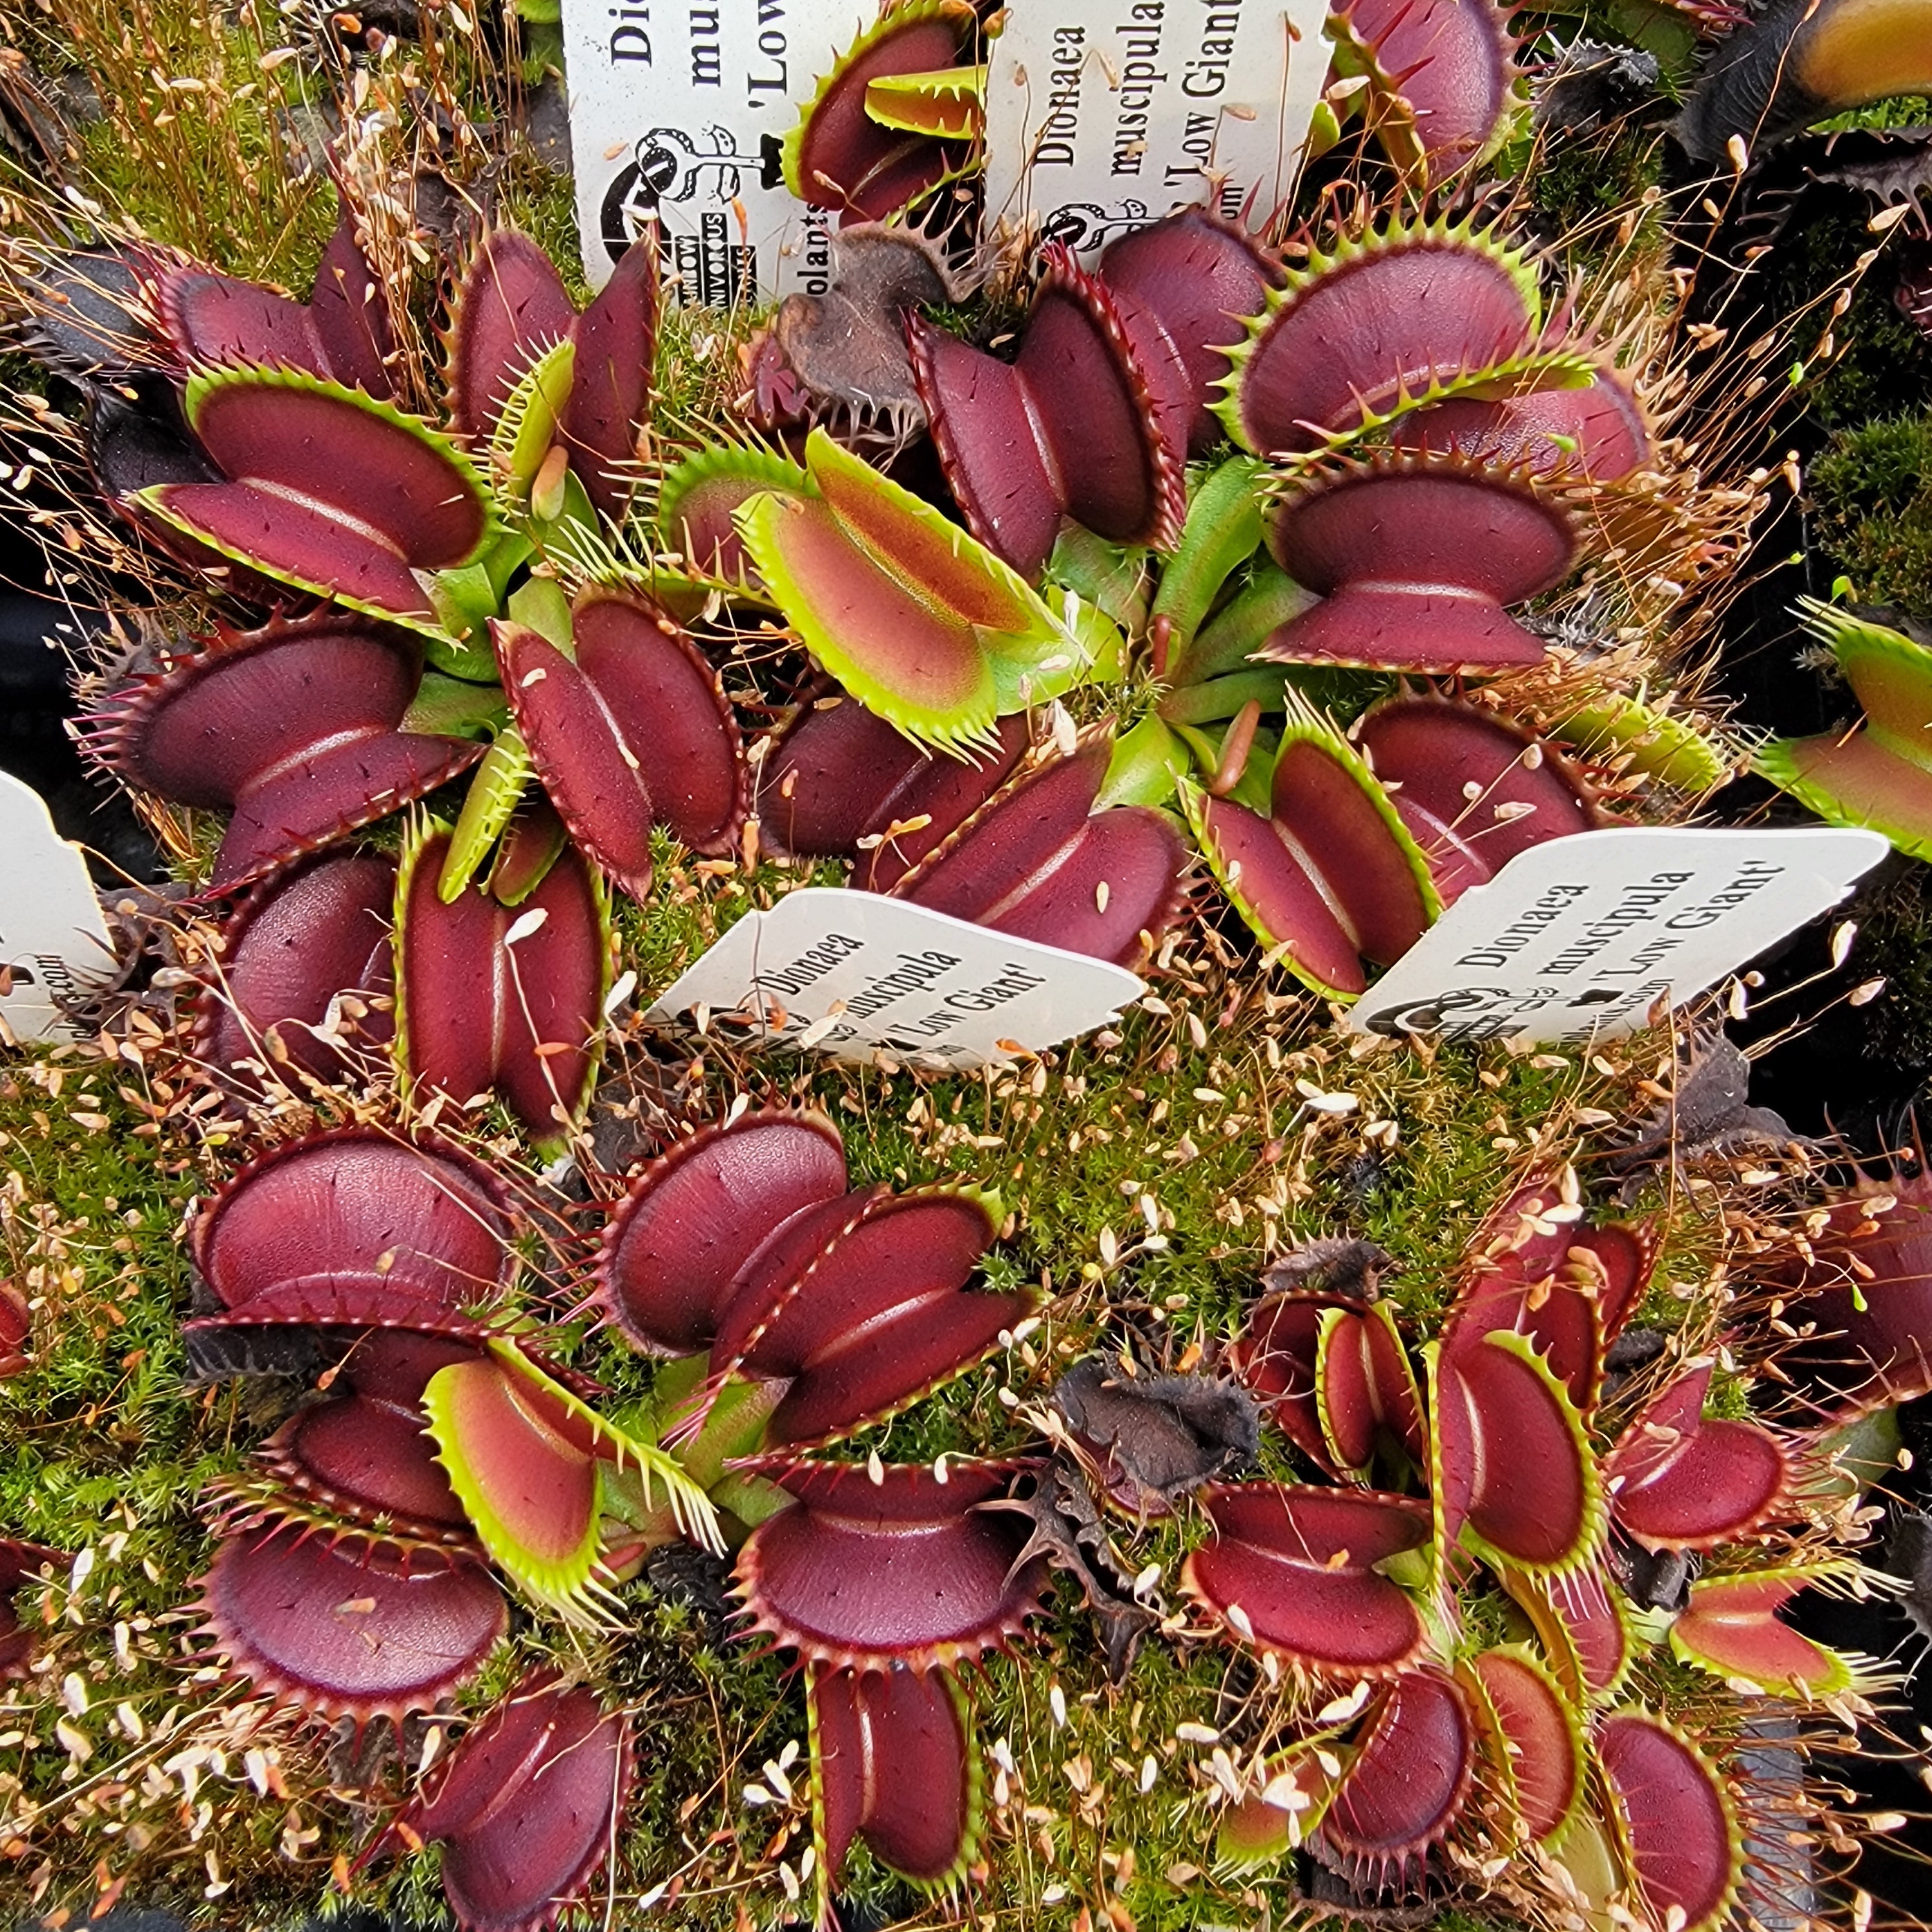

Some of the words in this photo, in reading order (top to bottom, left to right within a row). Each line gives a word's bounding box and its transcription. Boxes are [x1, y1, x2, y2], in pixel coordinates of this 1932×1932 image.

[608, 0, 652, 68] Di
[690, 0, 721, 88] mu
[1033, 26, 1085, 168] Dionaea
[1111, 1, 1168, 177] muscipula
[750, 934, 865, 995] Dionaea
[1454, 885, 1589, 968] Dionaea
[1537, 872, 1695, 975] muscipula
[847, 951, 962, 1019] muscipula
